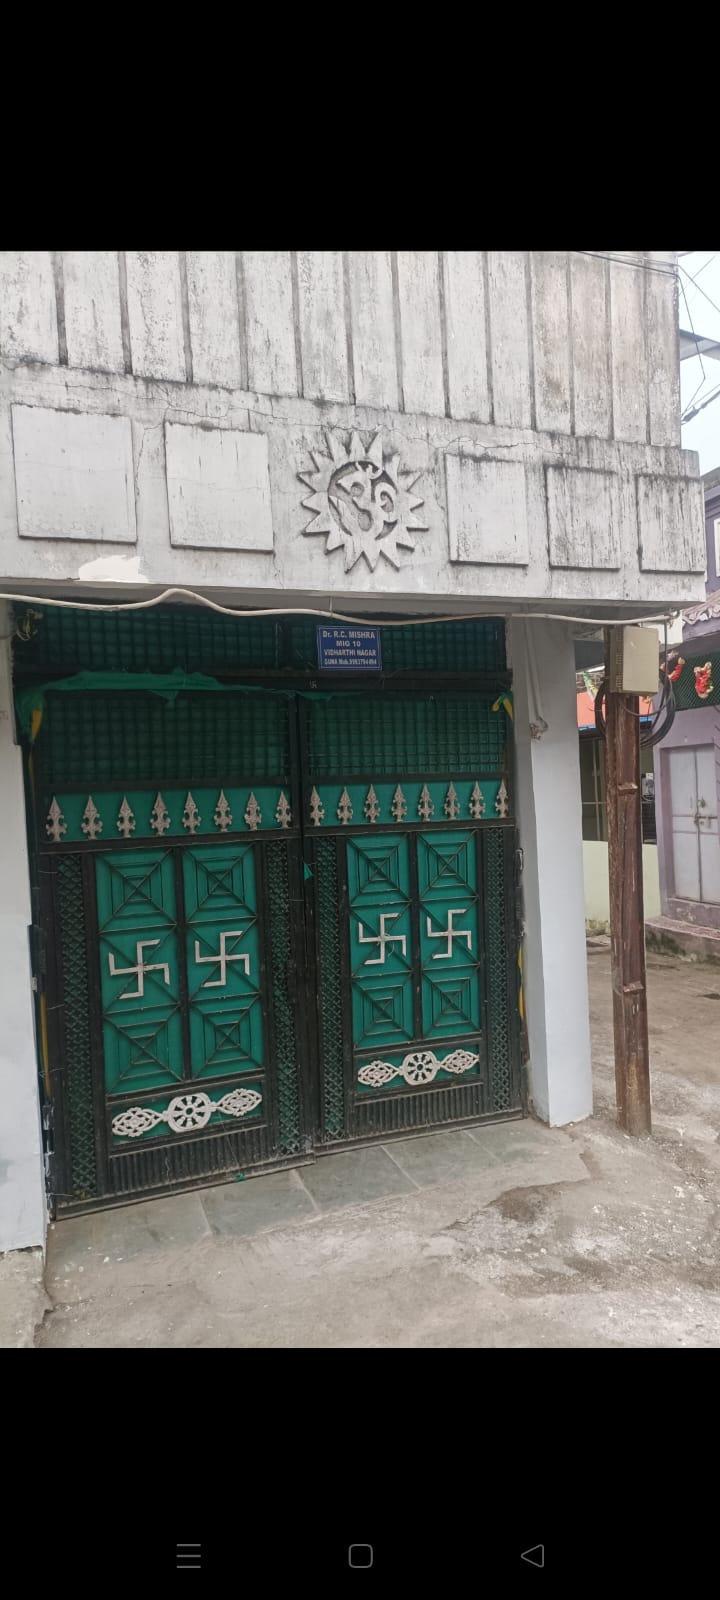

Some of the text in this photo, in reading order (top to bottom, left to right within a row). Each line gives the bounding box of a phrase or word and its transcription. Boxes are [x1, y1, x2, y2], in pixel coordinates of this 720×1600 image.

[322, 630, 332, 638] Dr.
[348, 631, 376, 639] MISHRA
[353, 640, 361, 648] 10
[356, 649, 377, 657] NAGAR
